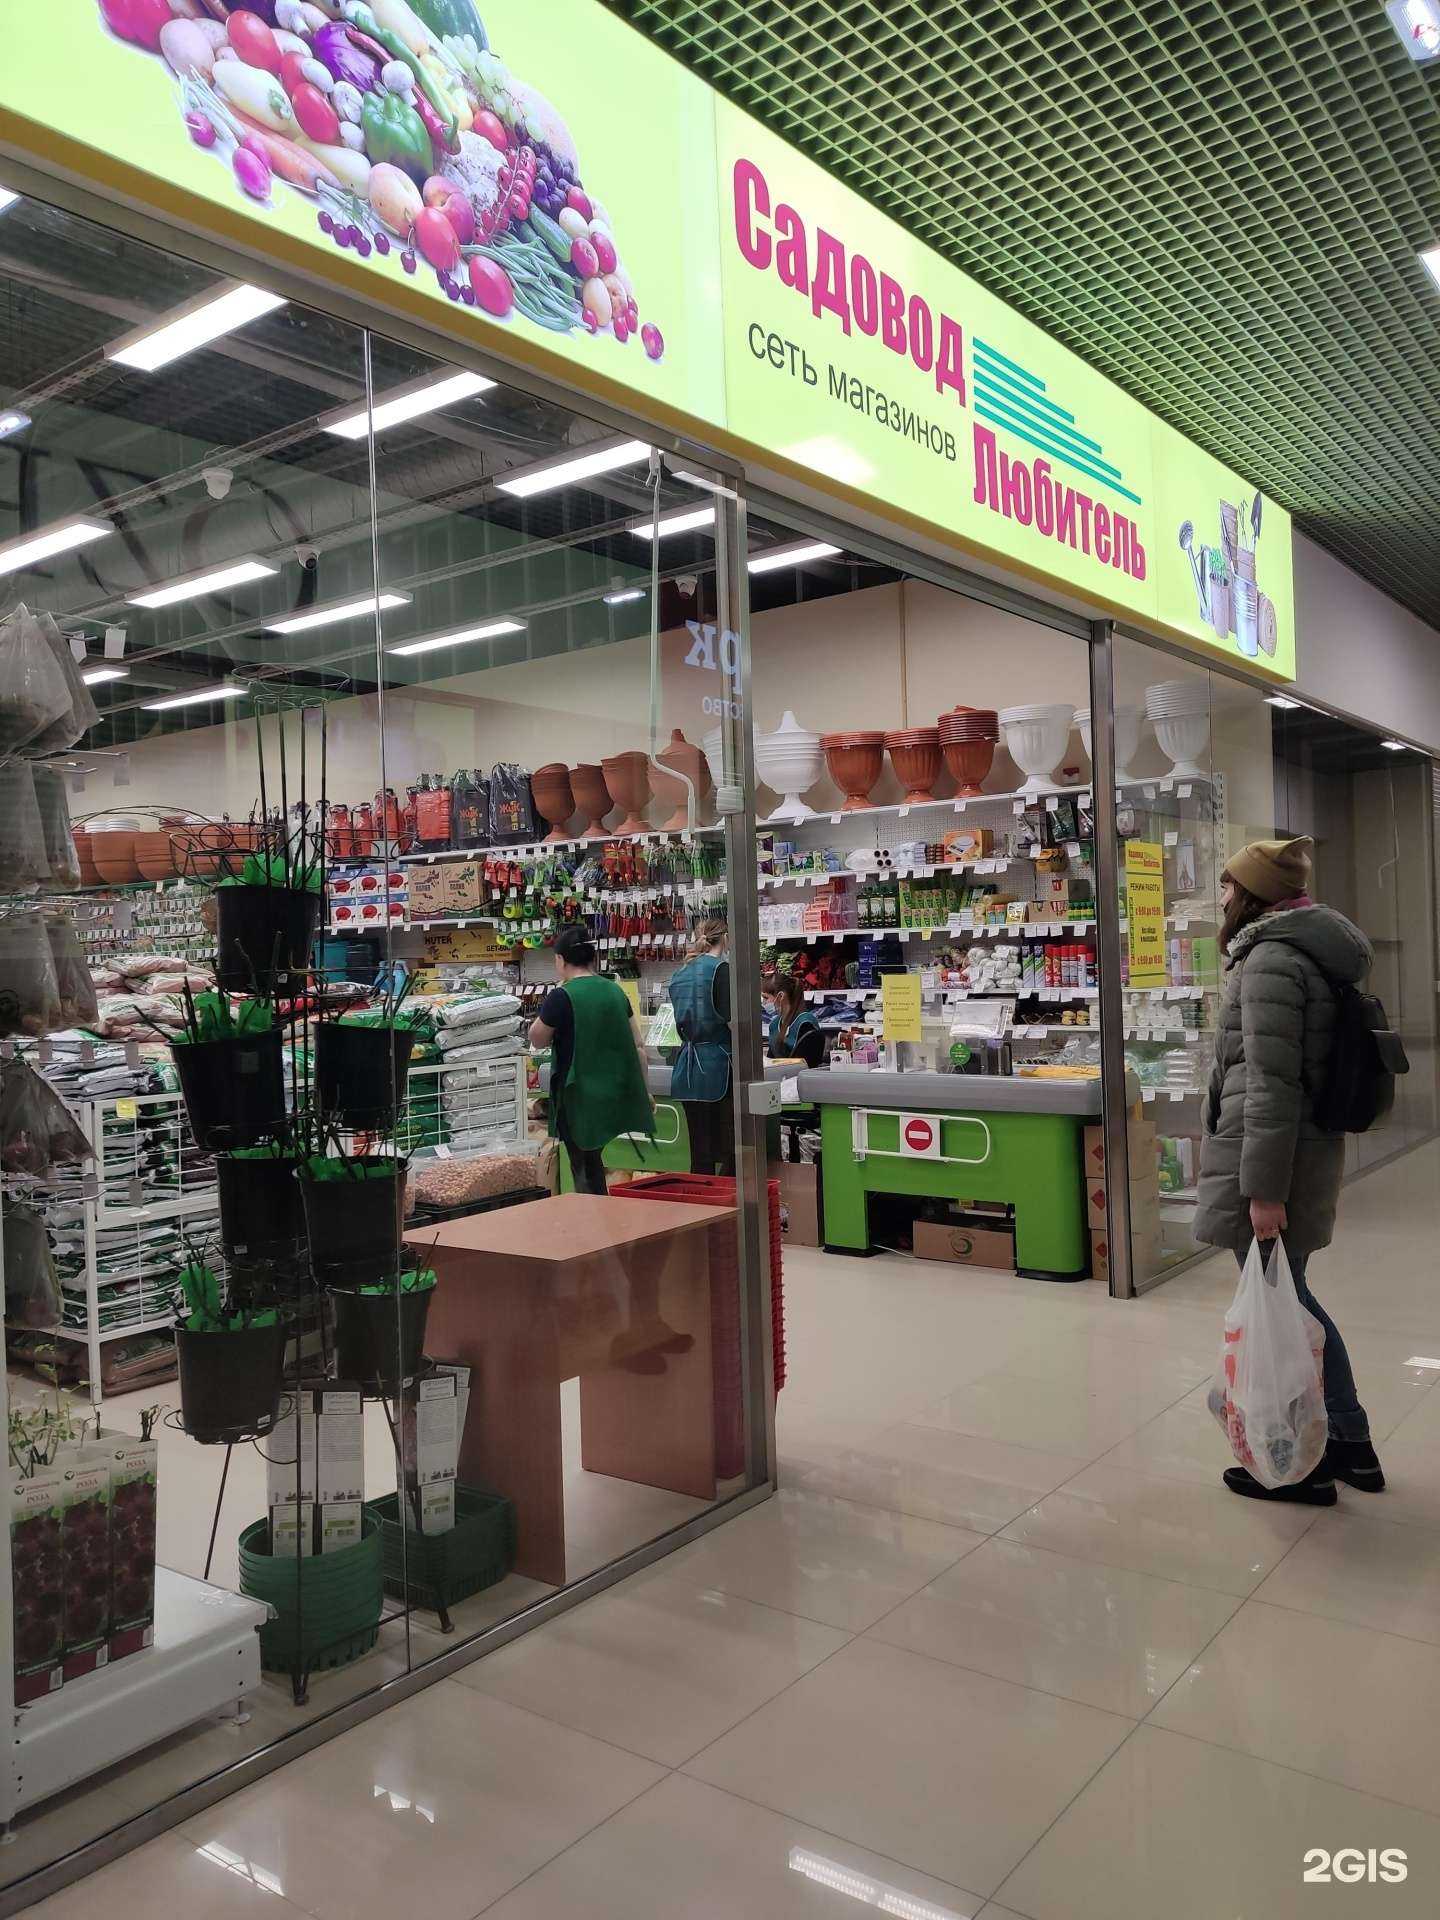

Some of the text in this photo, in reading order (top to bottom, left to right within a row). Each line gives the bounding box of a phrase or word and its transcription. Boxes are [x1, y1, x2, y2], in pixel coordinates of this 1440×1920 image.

[734, 158, 966, 408] Садовод
[748, 322, 957, 463] сеть магазинов
[973, 421, 1146, 582] Любитель
